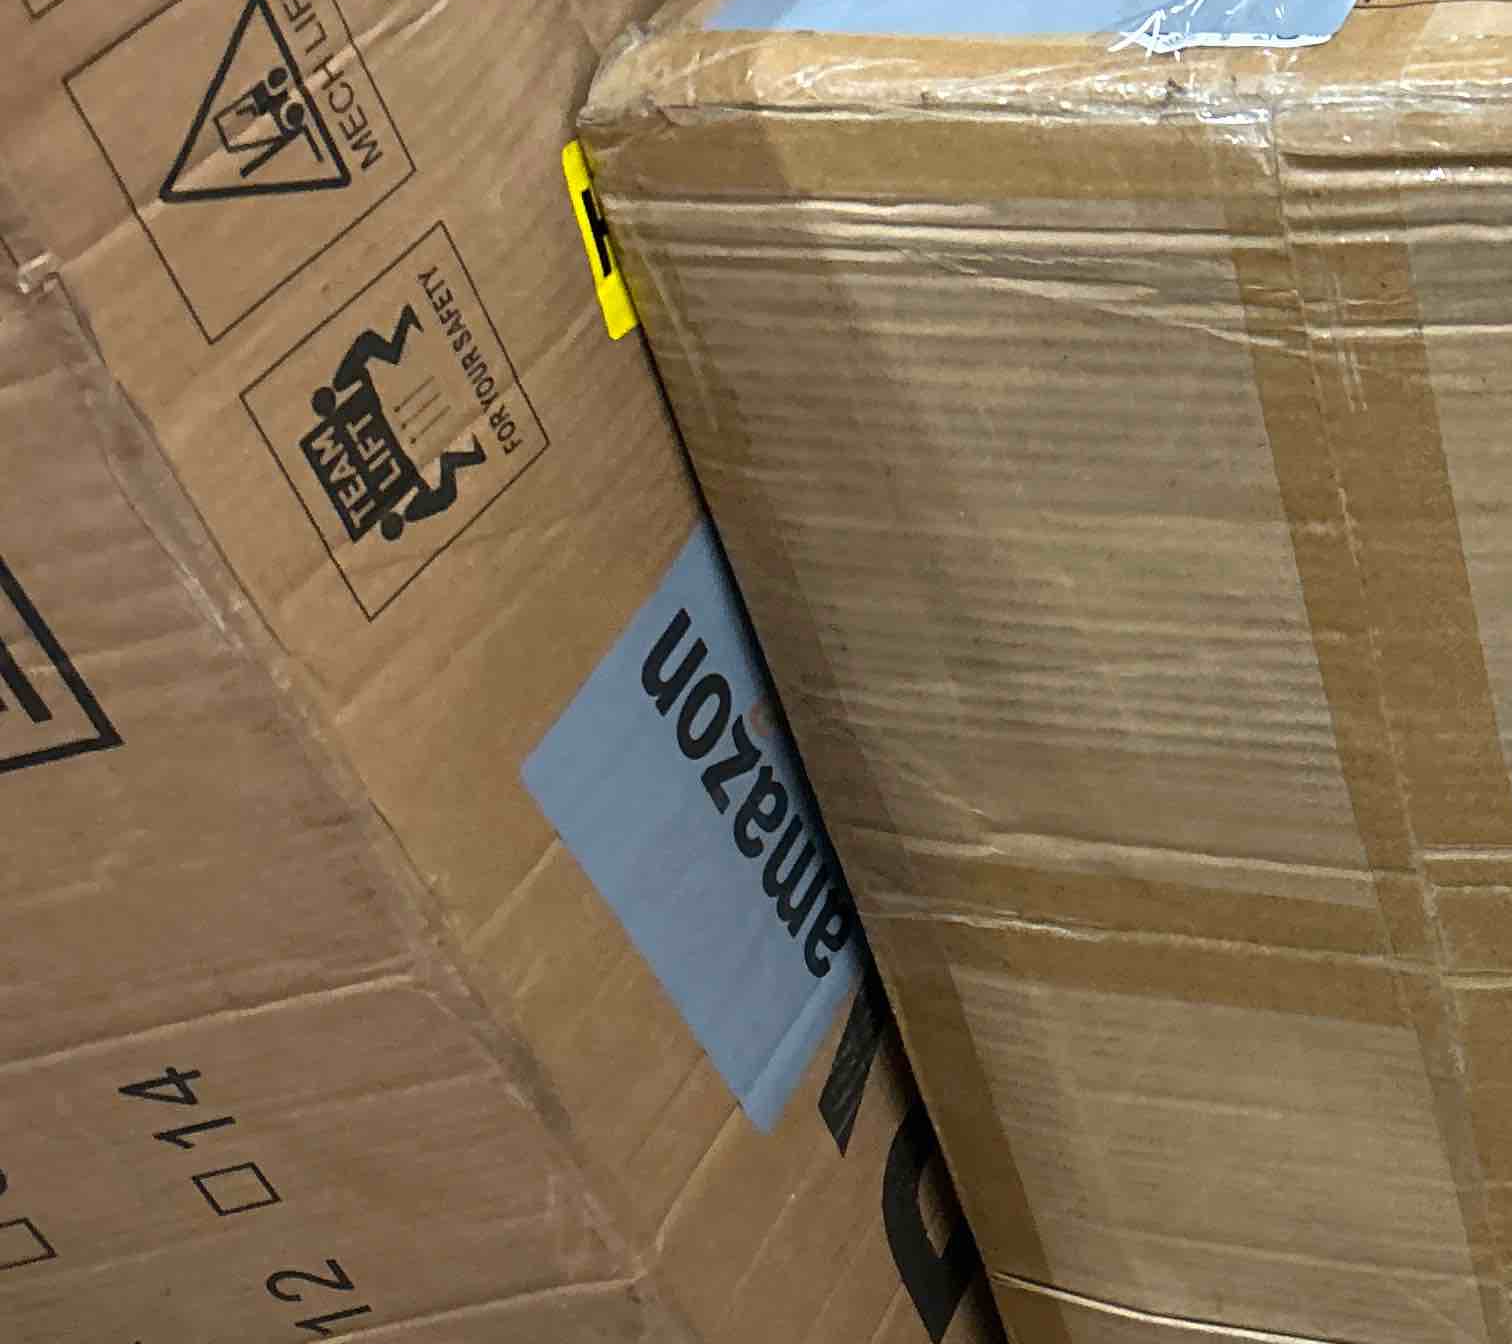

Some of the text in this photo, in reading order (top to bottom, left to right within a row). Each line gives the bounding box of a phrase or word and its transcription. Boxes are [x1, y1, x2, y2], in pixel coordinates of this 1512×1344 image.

[313, 53, 384, 170] MECH
[417, 266, 523, 455] FOR YOUR SAFETY
[311, 426, 375, 528] TEAM
[346, 413, 401, 492] LIFT
[641, 608, 852, 978] amazon
[117, 1066, 236, 1149] 14
[266, 1259, 372, 1336] 12
